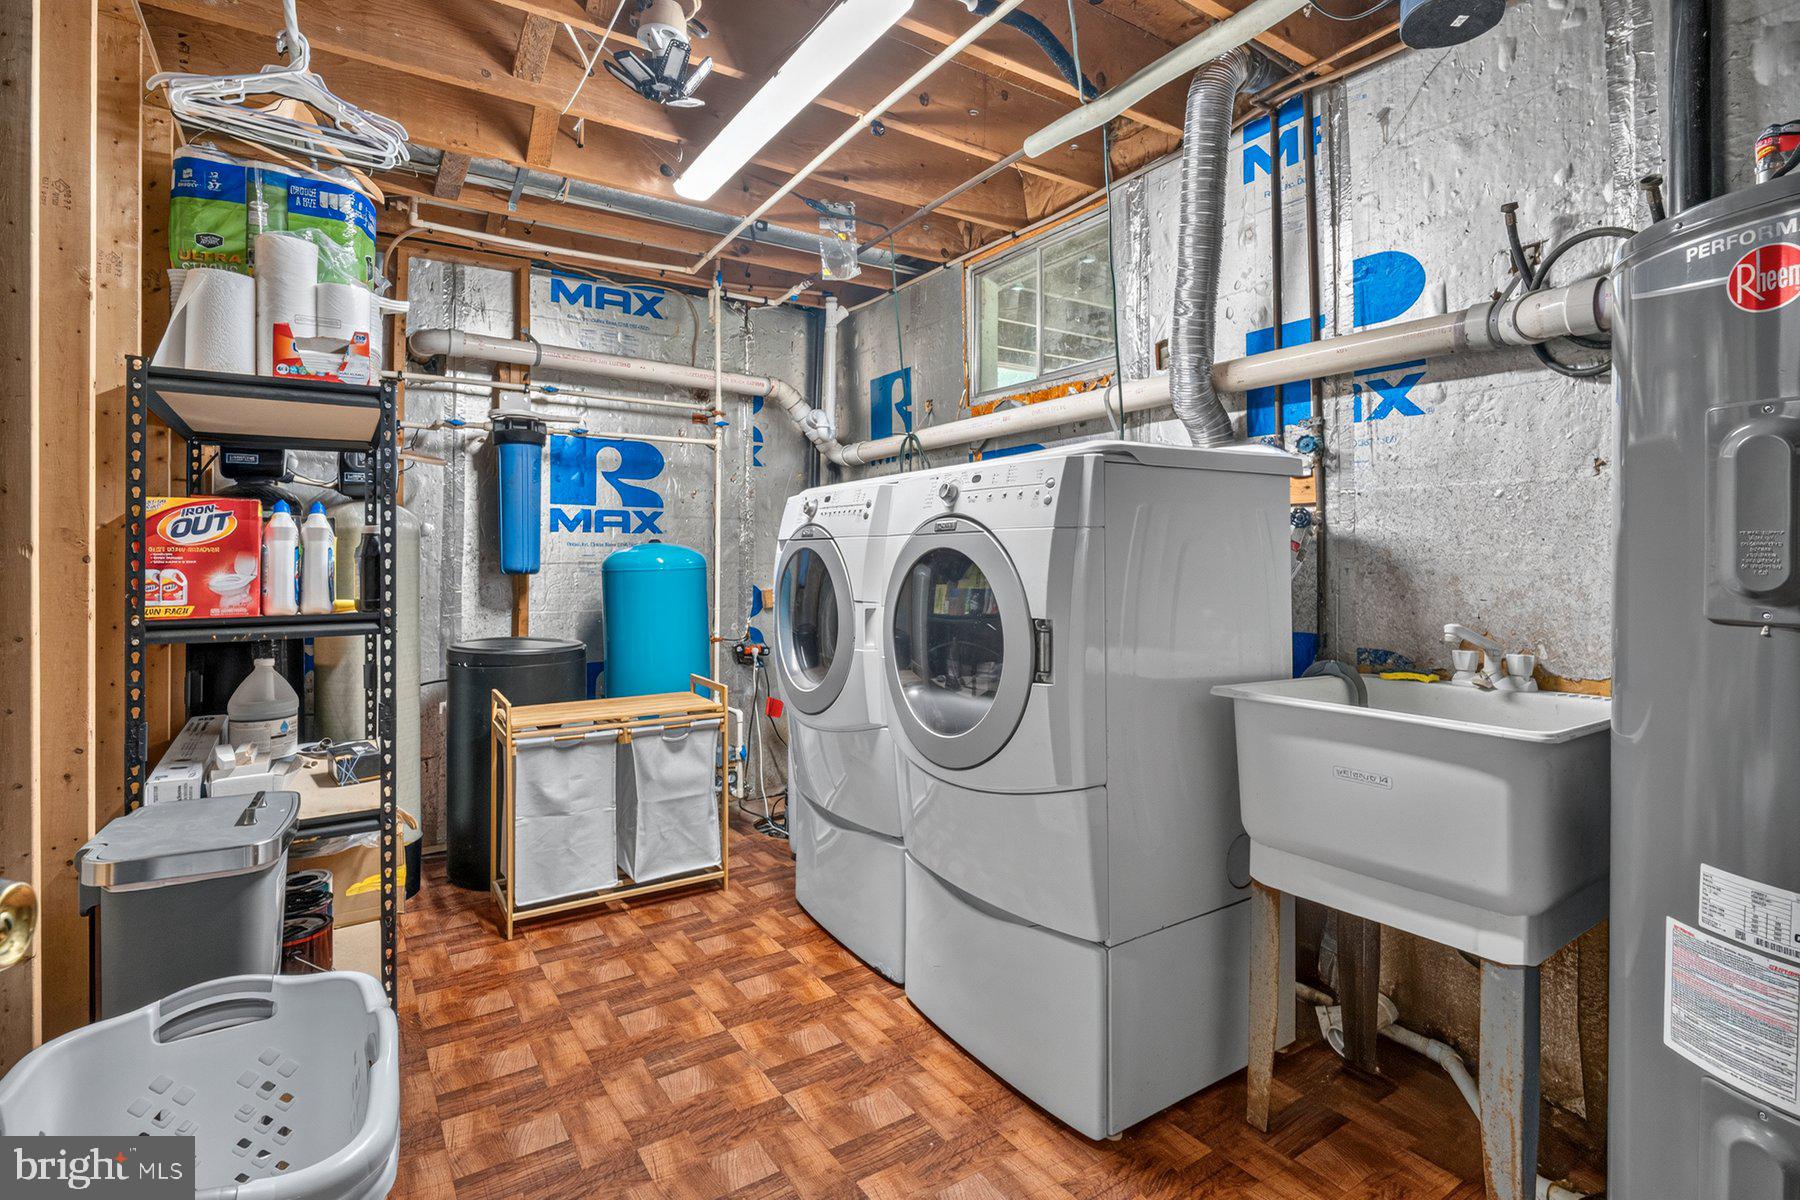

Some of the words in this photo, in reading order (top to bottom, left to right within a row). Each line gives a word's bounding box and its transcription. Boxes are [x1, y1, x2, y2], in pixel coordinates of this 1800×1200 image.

[1685, 217, 1800, 263] PERFORM
[178, 249, 241, 263] ULTRA
[550, 278, 664, 320] MAX
[180, 504, 216, 517] IRON
[550, 508, 664, 534] MAX
[170, 511, 233, 538] OUT
